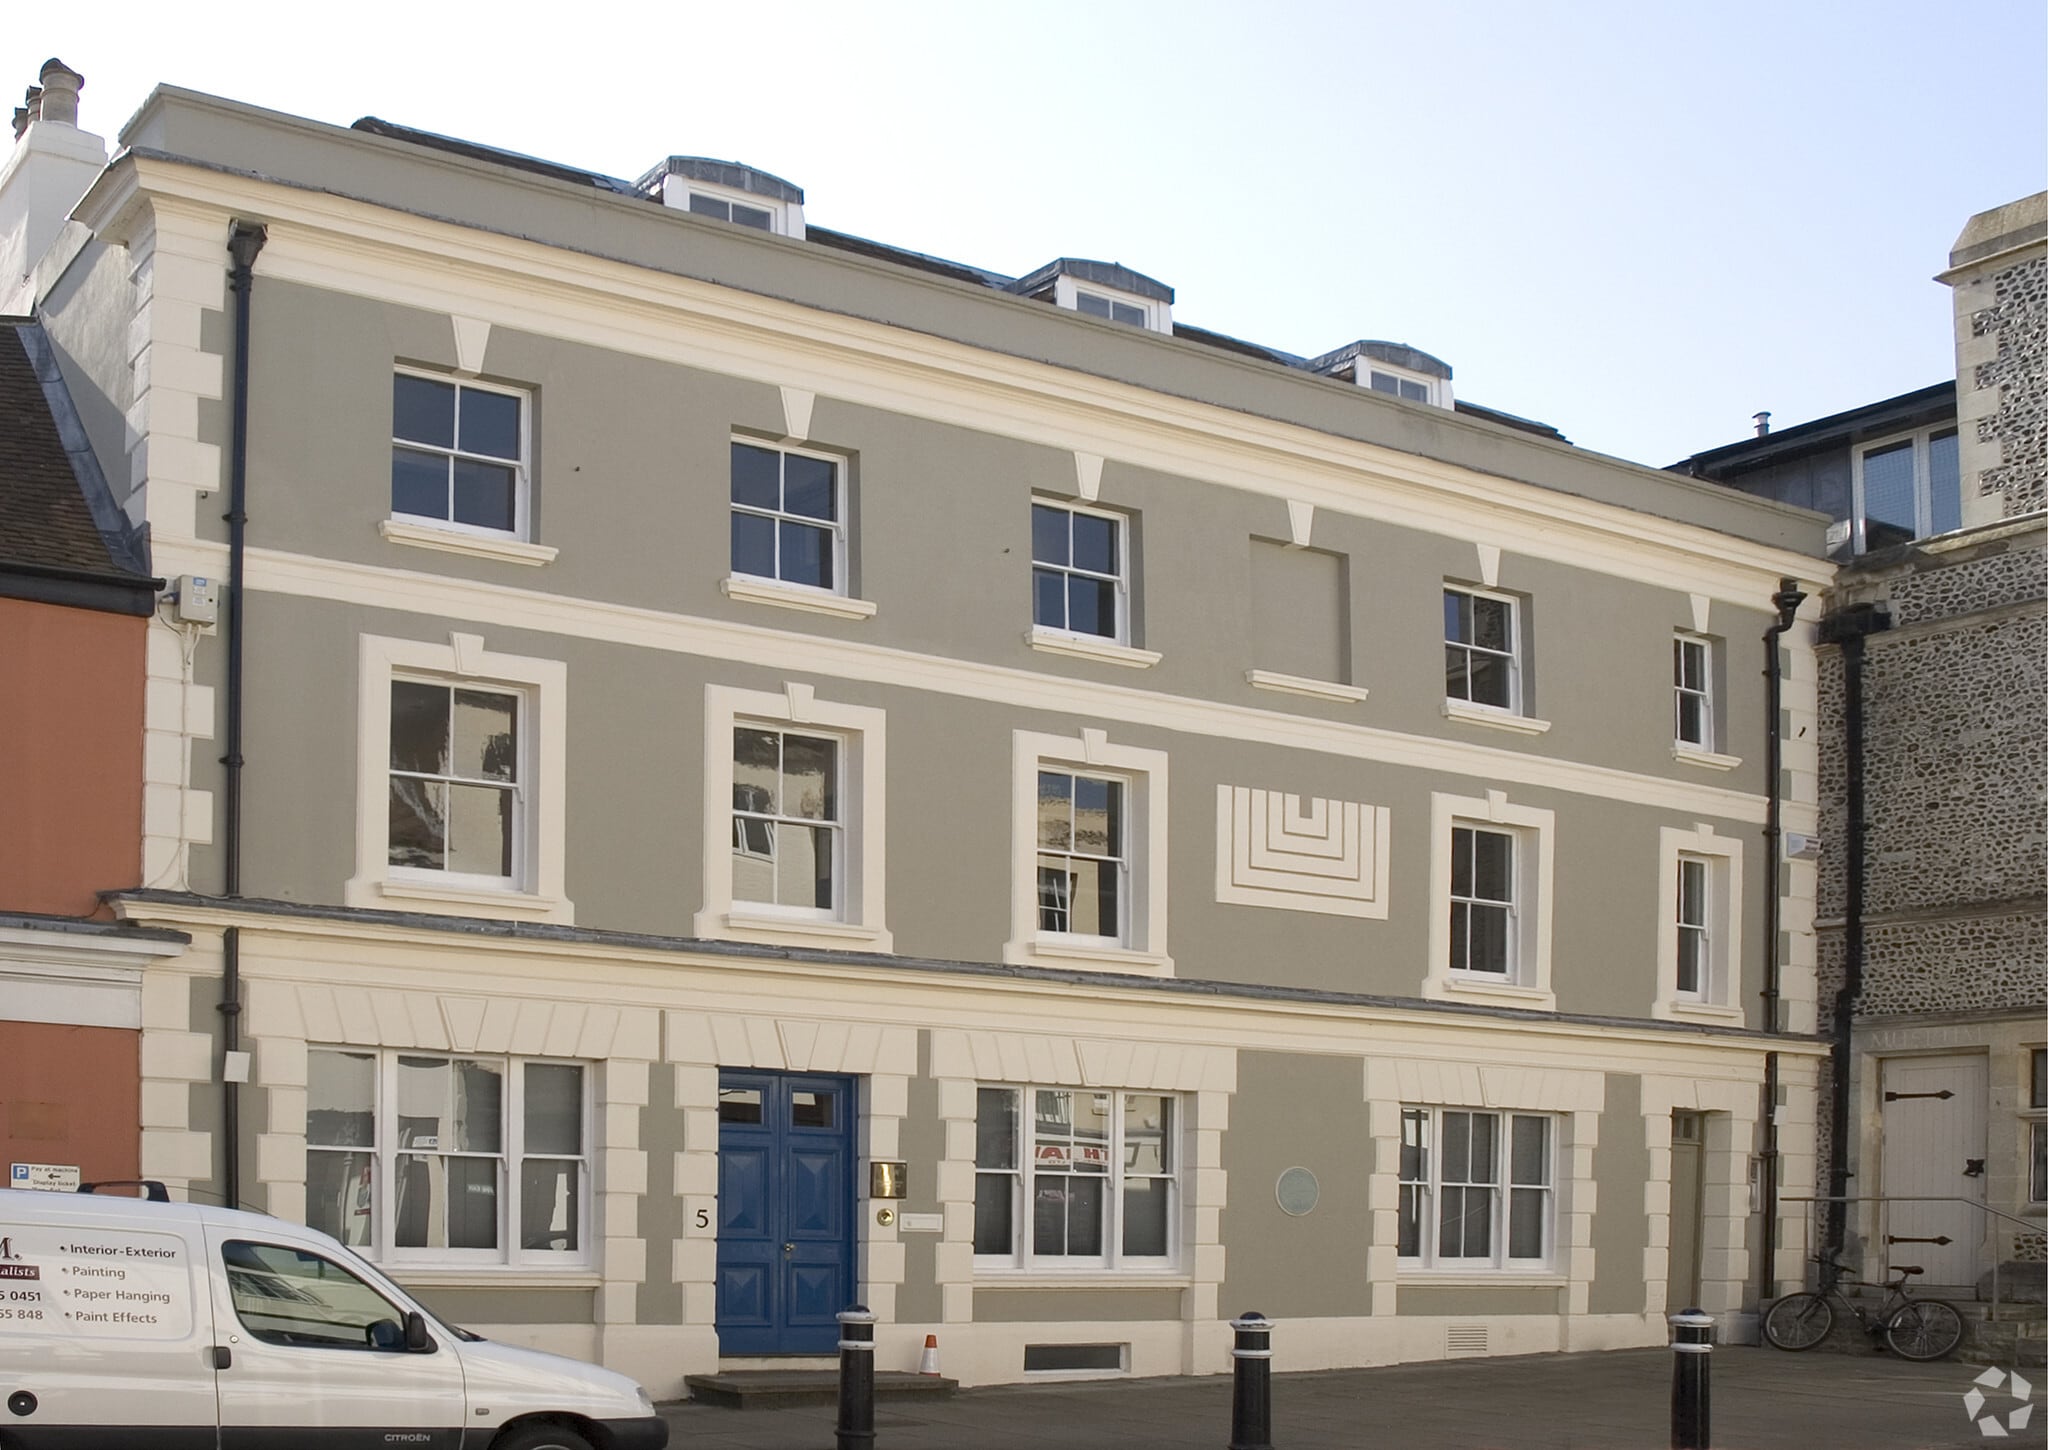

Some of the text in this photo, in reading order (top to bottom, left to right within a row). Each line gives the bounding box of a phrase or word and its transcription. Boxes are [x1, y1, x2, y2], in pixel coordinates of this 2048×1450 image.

[16, 1167, 27, 1178] P
[695, 1209, 709, 1229] 5
[70, 1244, 176, 1258] Interior-Exterior
[72, 1266, 126, 1280] Painting
[10, 1291, 41, 1301] 0451
[74, 1288, 170, 1304] Paper Hanging
[17, 1309, 43, 1320] 848
[76, 1311, 158, 1323] Paint Effects
